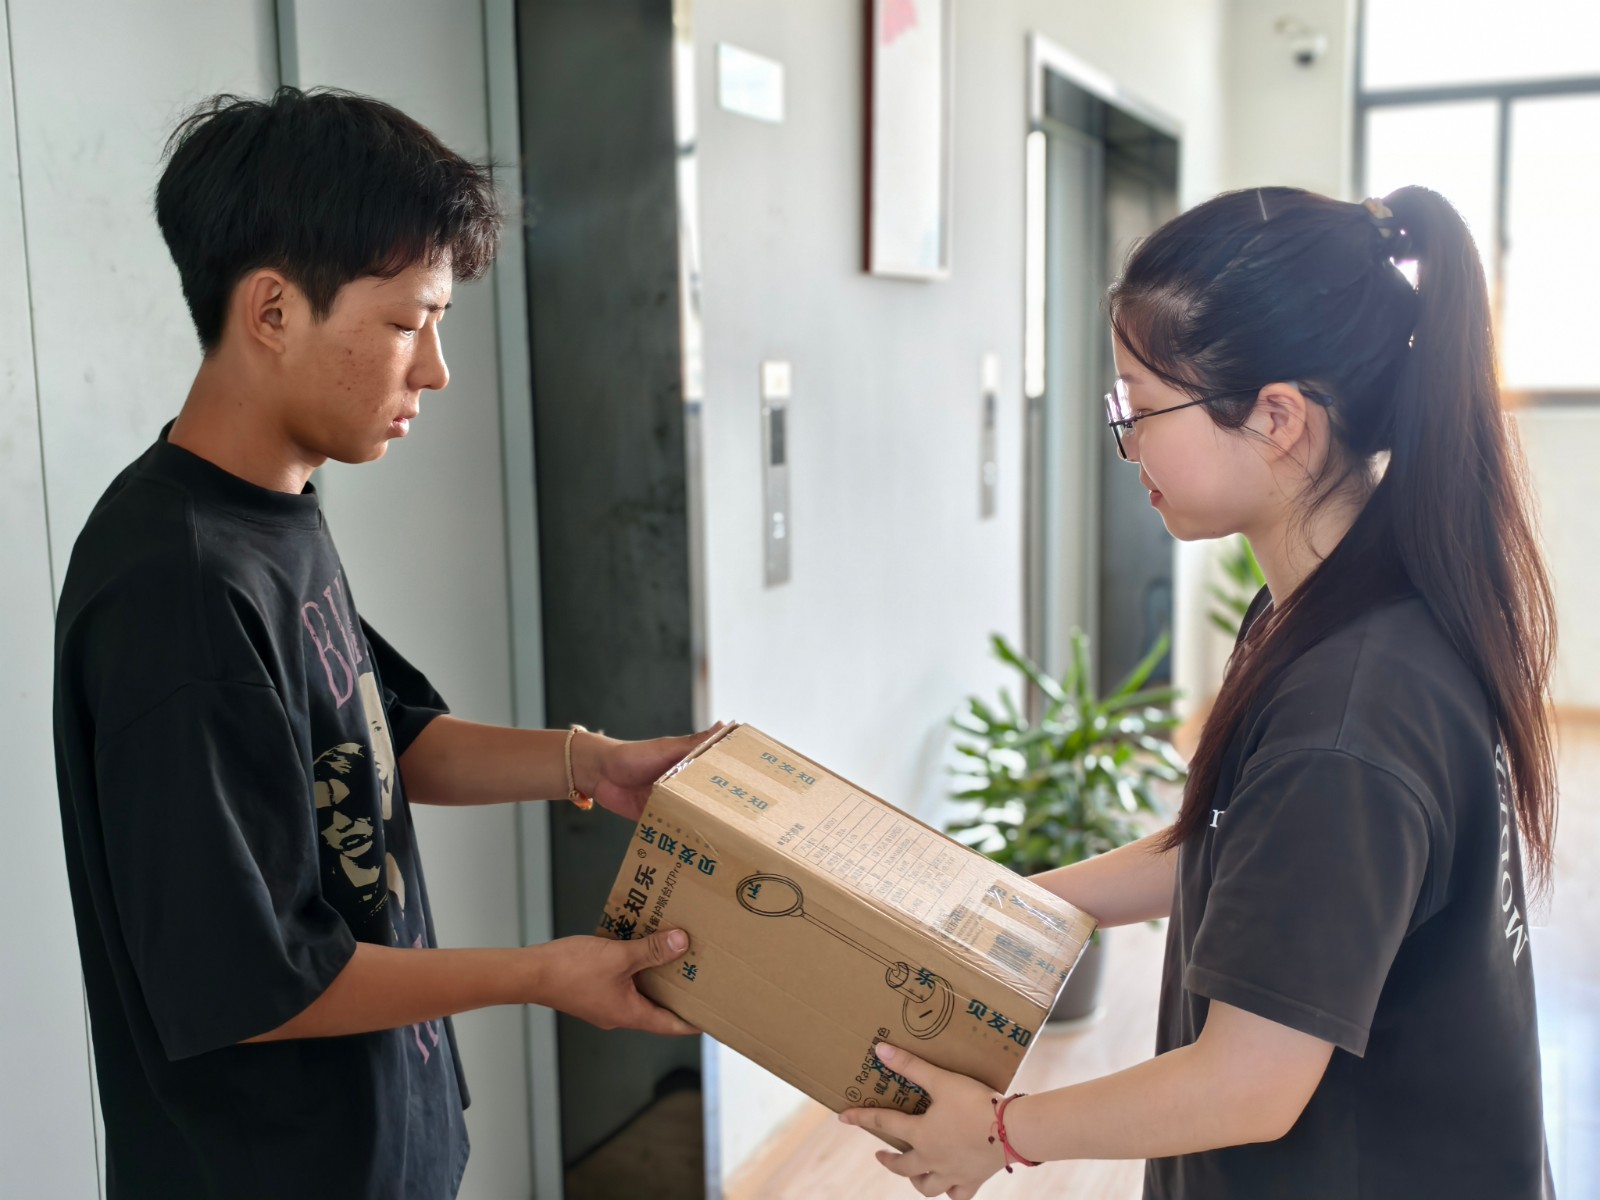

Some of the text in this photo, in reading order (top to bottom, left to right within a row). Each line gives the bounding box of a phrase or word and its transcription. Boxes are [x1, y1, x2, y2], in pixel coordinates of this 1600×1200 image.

[639, 823, 717, 876] 贝发知乐
[682, 961, 698, 982] 乐
[915, 967, 1032, 1048] 乐 贝发知
